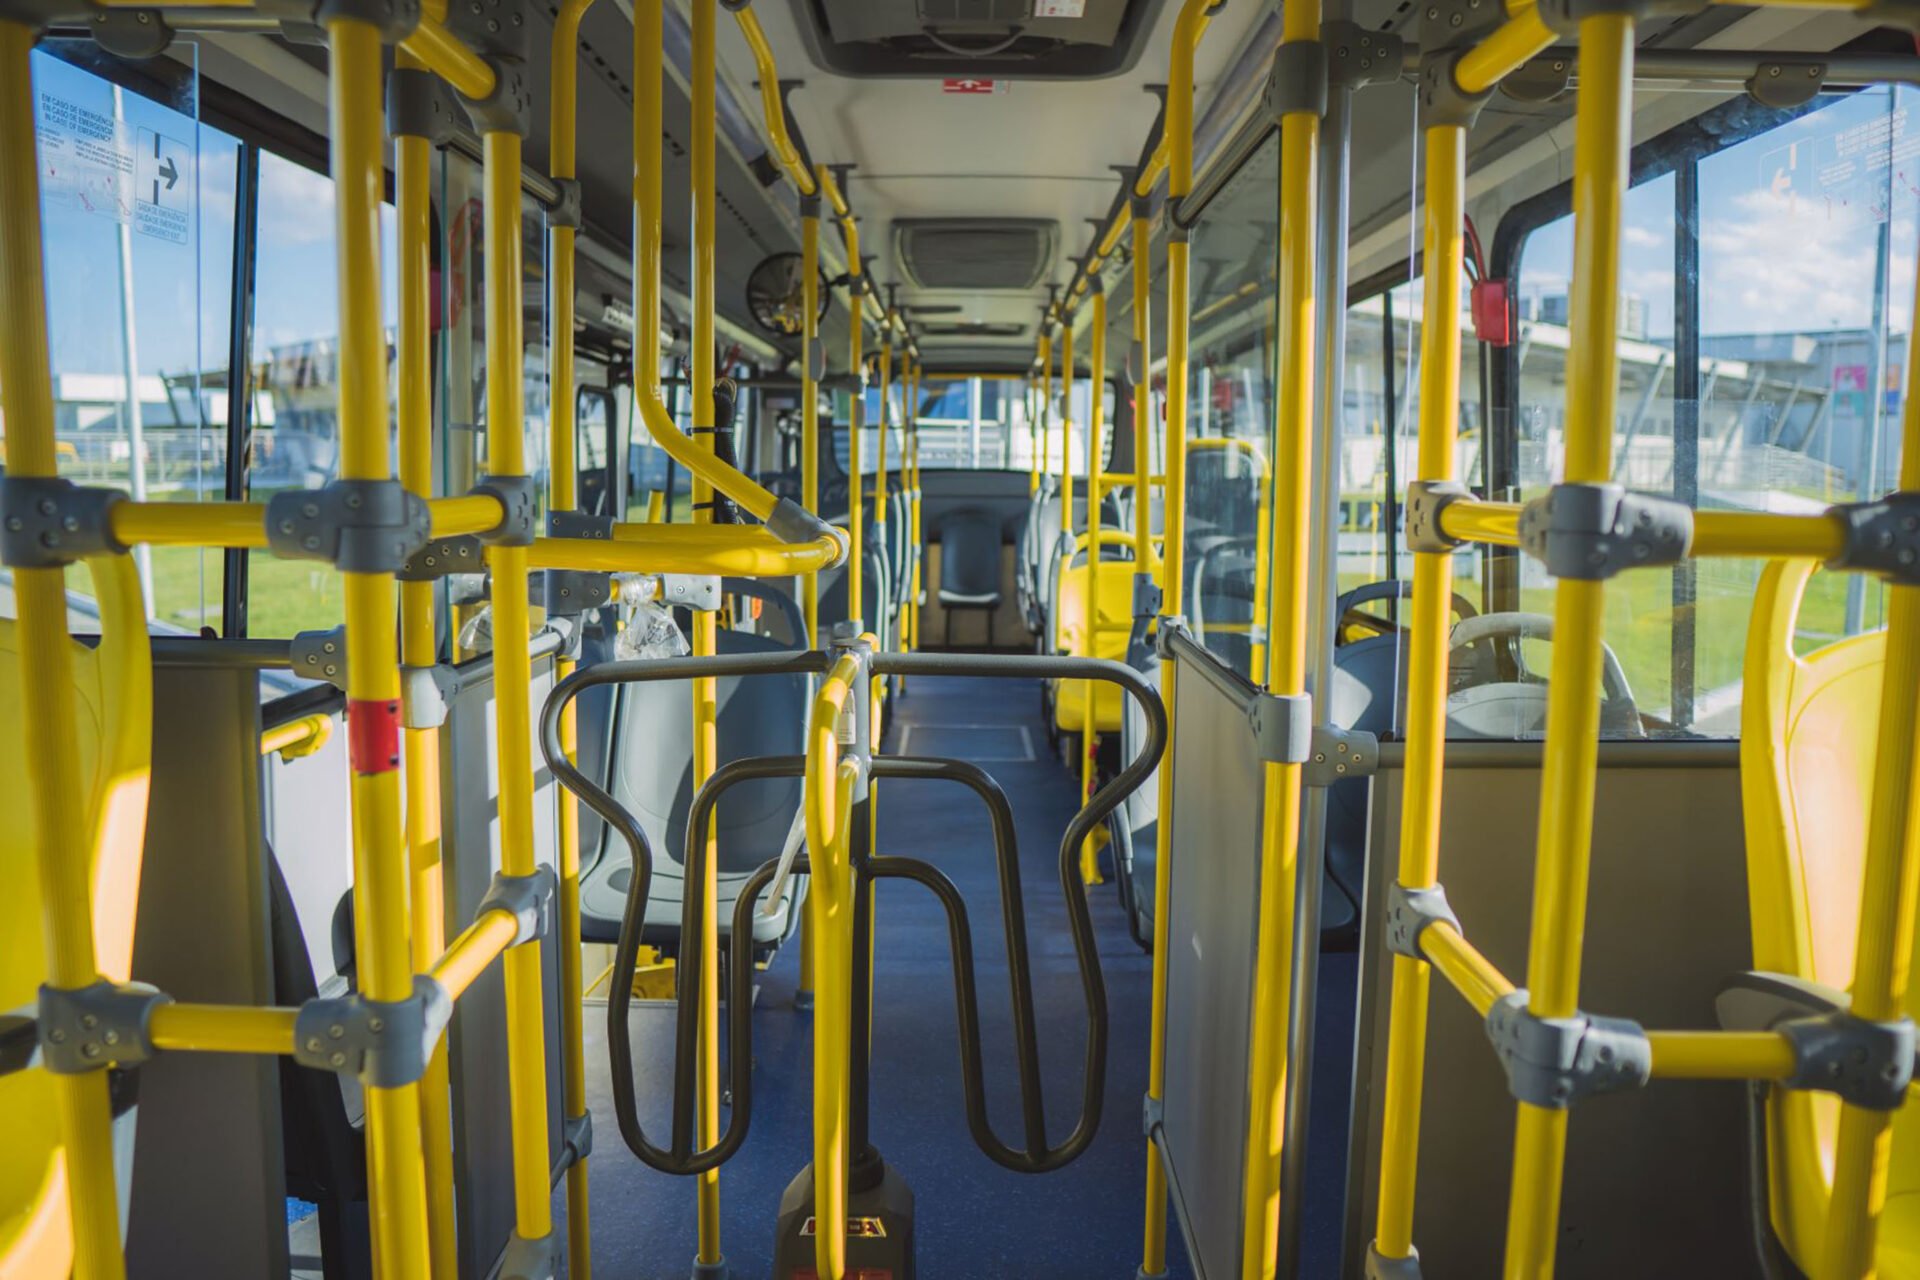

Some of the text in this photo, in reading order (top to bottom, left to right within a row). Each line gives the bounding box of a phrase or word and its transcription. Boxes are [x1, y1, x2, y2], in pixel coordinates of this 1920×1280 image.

[52, 96, 69, 110] CASO
[52, 106, 69, 118] CASO
[78, 116, 113, 135] EMERGENCIA
[52, 115, 68, 127] CASE
[77, 125, 112, 142] EMERGENCY
